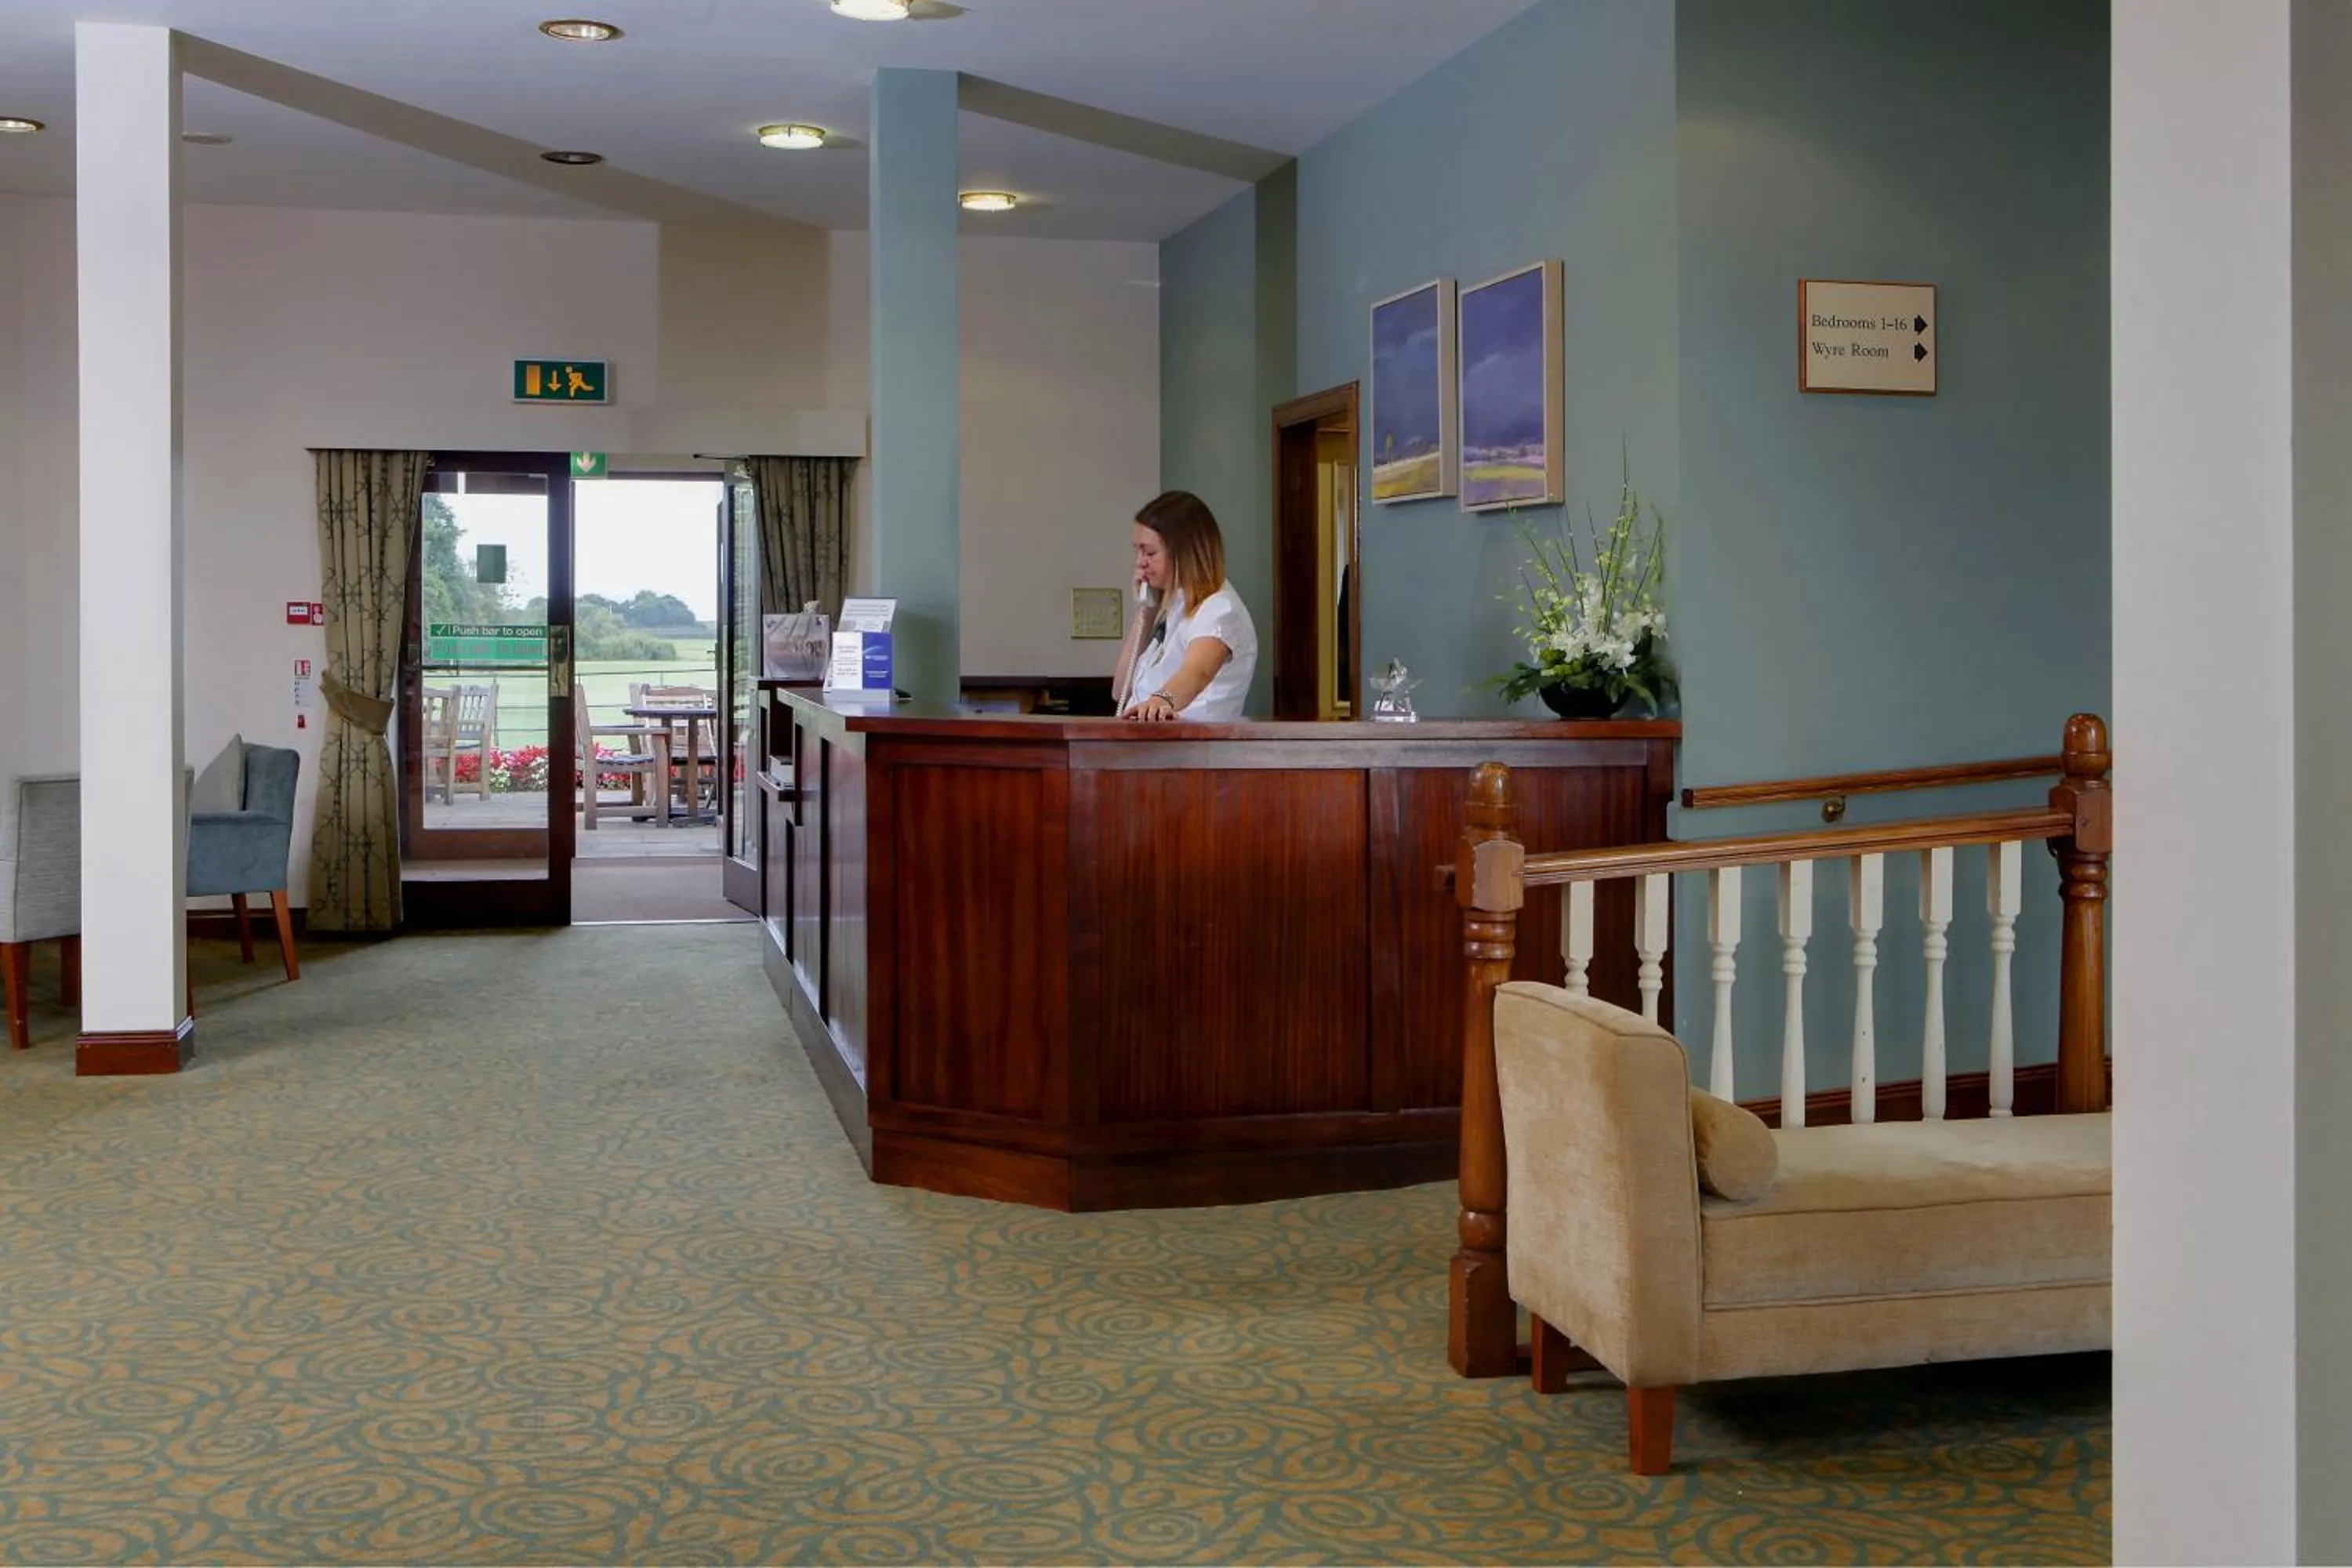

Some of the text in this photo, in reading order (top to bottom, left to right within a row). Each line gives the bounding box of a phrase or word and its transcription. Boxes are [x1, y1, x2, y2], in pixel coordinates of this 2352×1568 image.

[1812, 314, 1907, 331] Bedrooms 1-16
[1812, 341, 1889, 360] Wyre Room
[452, 626, 543, 637] Push bar to open
